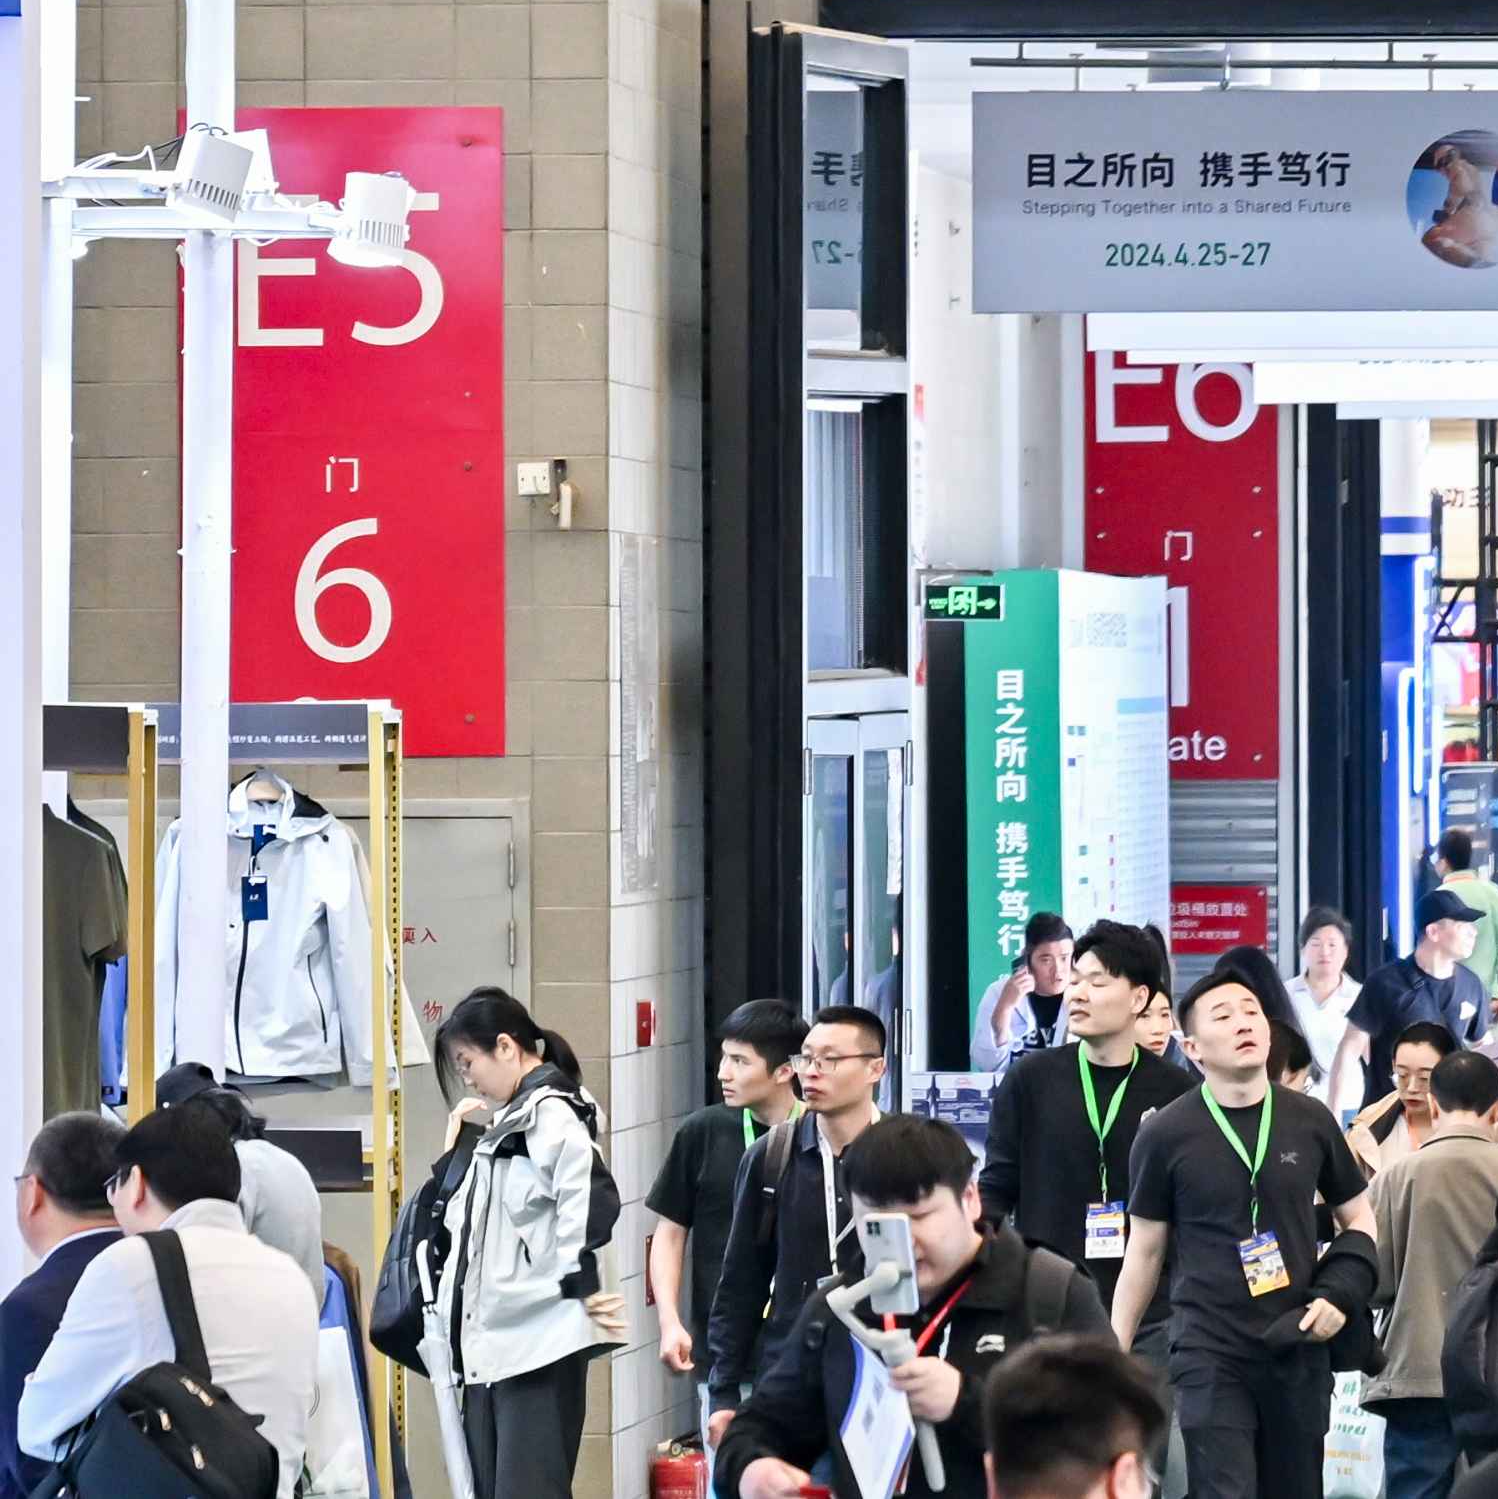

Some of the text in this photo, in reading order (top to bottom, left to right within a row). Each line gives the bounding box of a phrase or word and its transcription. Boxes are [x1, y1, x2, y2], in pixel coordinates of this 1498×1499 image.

[1025, 150, 1351, 189] 目之所向 携手笃行
[1022, 198, 1352, 216] Stepping Together into a Shared Future
[237, 192, 445, 346] E5
[1104, 242, 1271, 267] 2024.4.25-27
[1096, 350, 1260, 443] E6
[324, 456, 360, 494] 门
[1163, 530, 1194, 562] 门
[293, 517, 393, 663] 6
[994, 668, 1028, 803] 目之所向
[1168, 729, 1228, 762] ate
[994, 821, 1029, 957] 携手笃行
